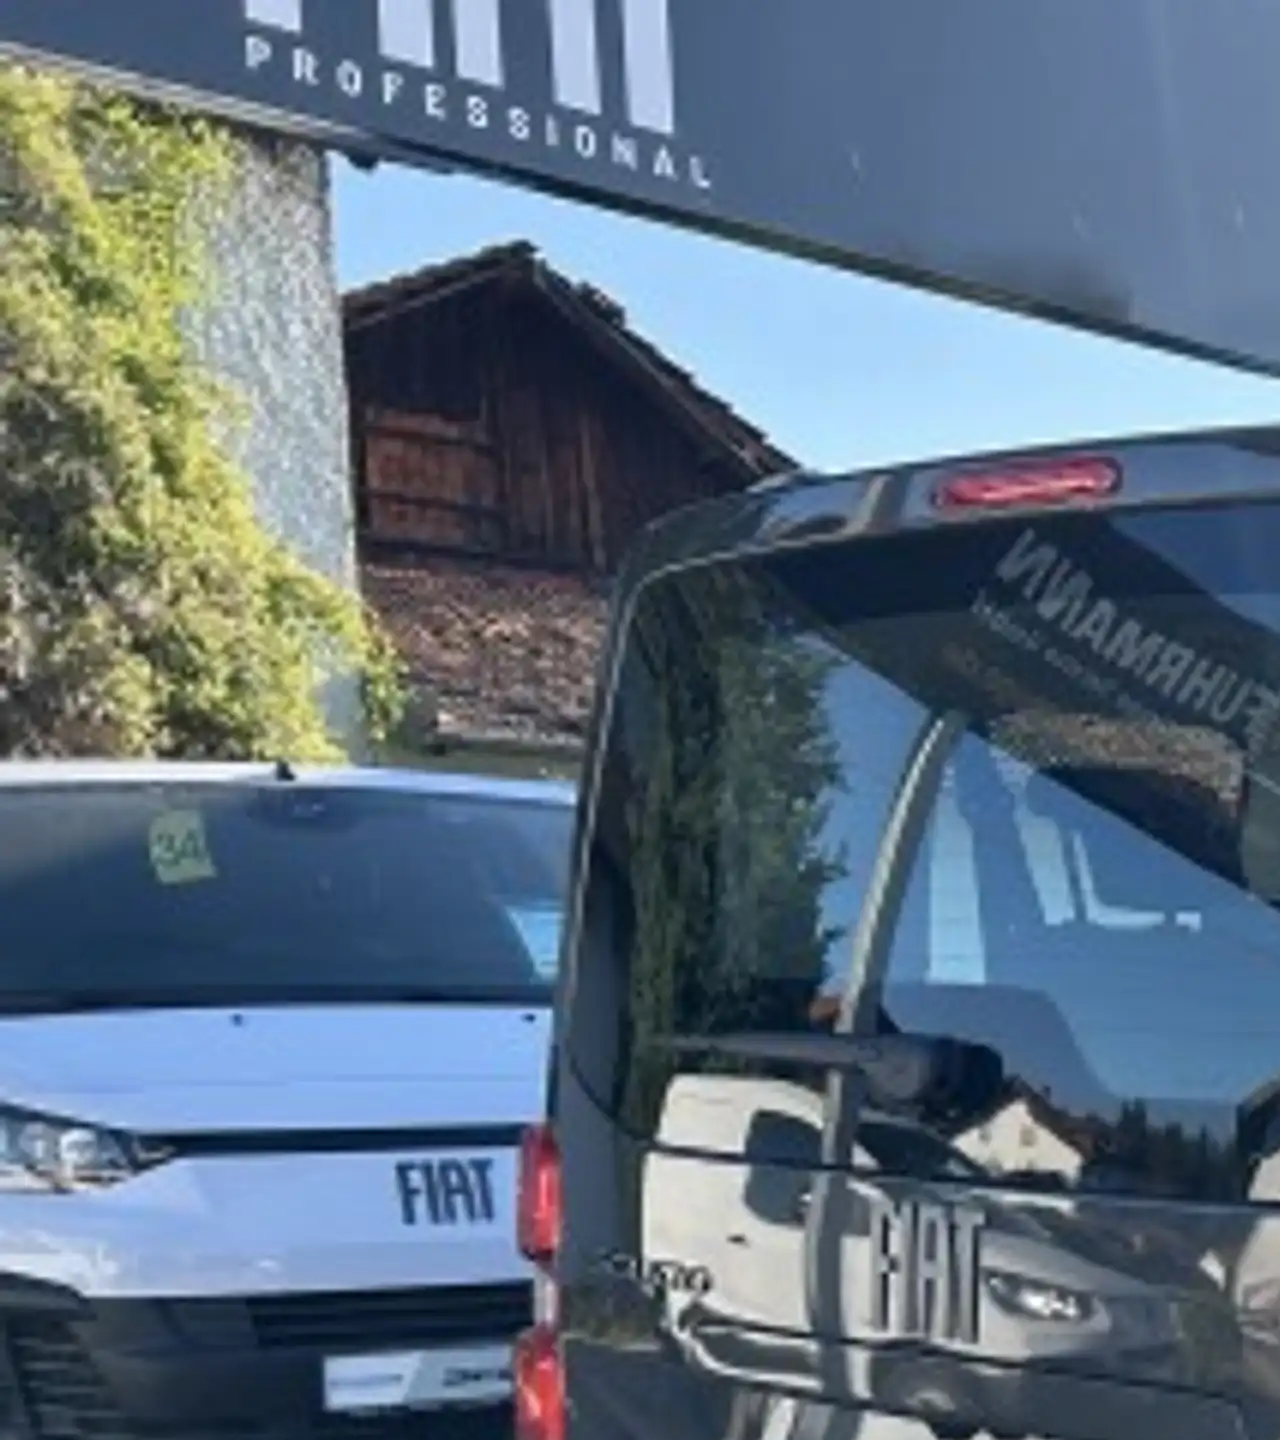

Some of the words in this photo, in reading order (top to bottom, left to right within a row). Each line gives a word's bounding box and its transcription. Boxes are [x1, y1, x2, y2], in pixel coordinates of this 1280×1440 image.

[244, 35, 713, 189] PROFESSIONAL
[395, 1156, 496, 1227] FIAT
[868, 1196, 986, 1344] FIAT
